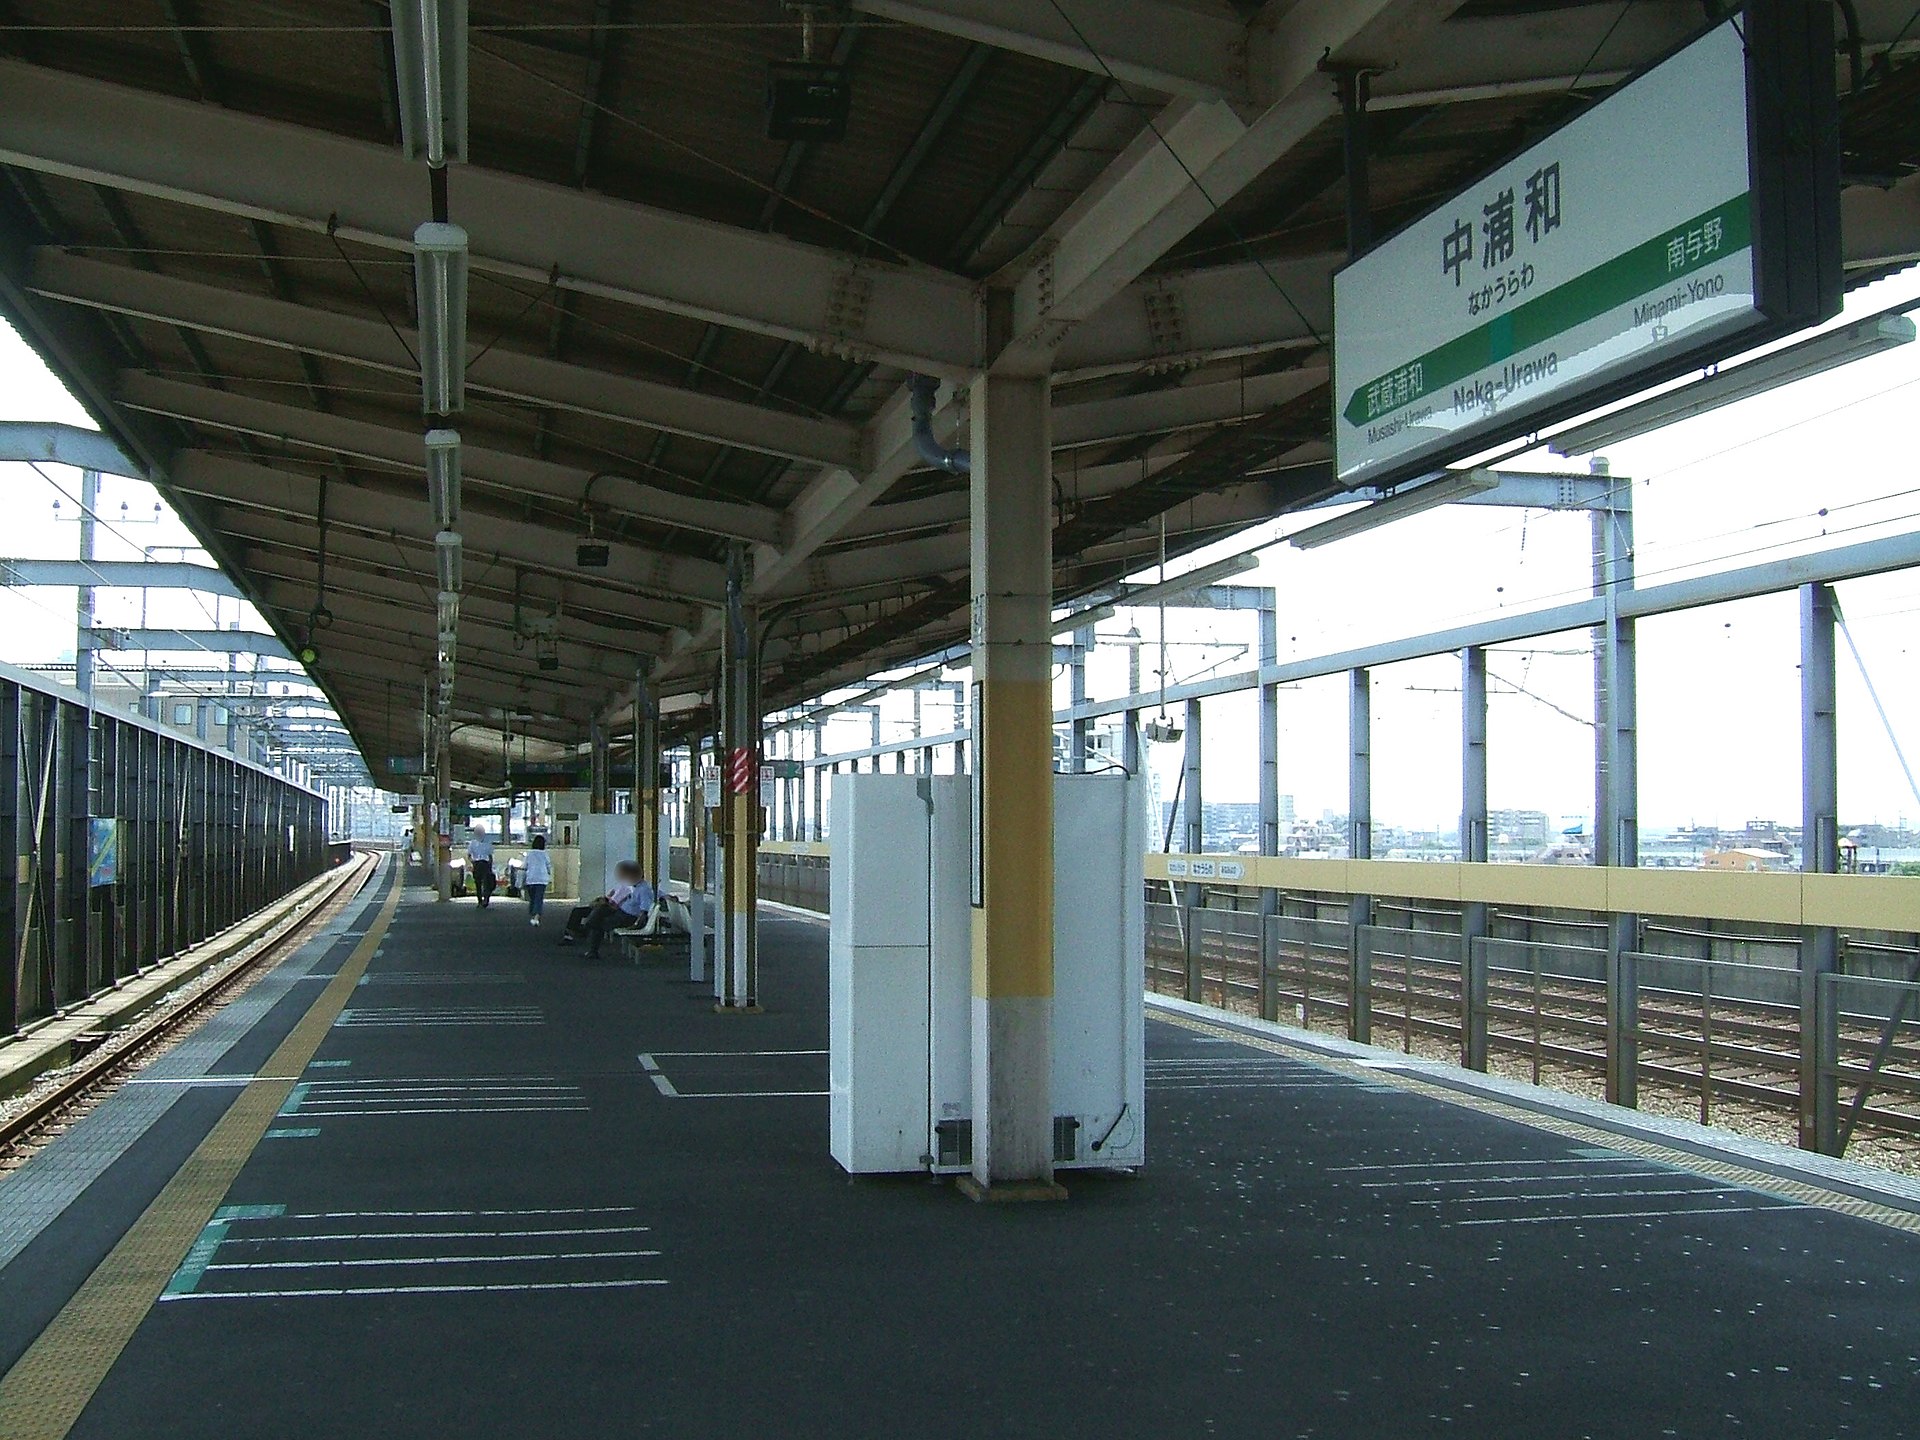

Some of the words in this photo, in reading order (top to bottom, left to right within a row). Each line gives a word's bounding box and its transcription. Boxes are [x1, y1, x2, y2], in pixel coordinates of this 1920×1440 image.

[1442, 161, 1561, 288] 中浦和
[1666, 216, 1724, 273] 南与野
[1468, 261, 1535, 317] なかうらわ
[1633, 273, 1724, 328] Minami-Yono
[1367, 362, 1423, 418] 武蔵浦和
[1453, 351, 1558, 417] Naka-Urawa
